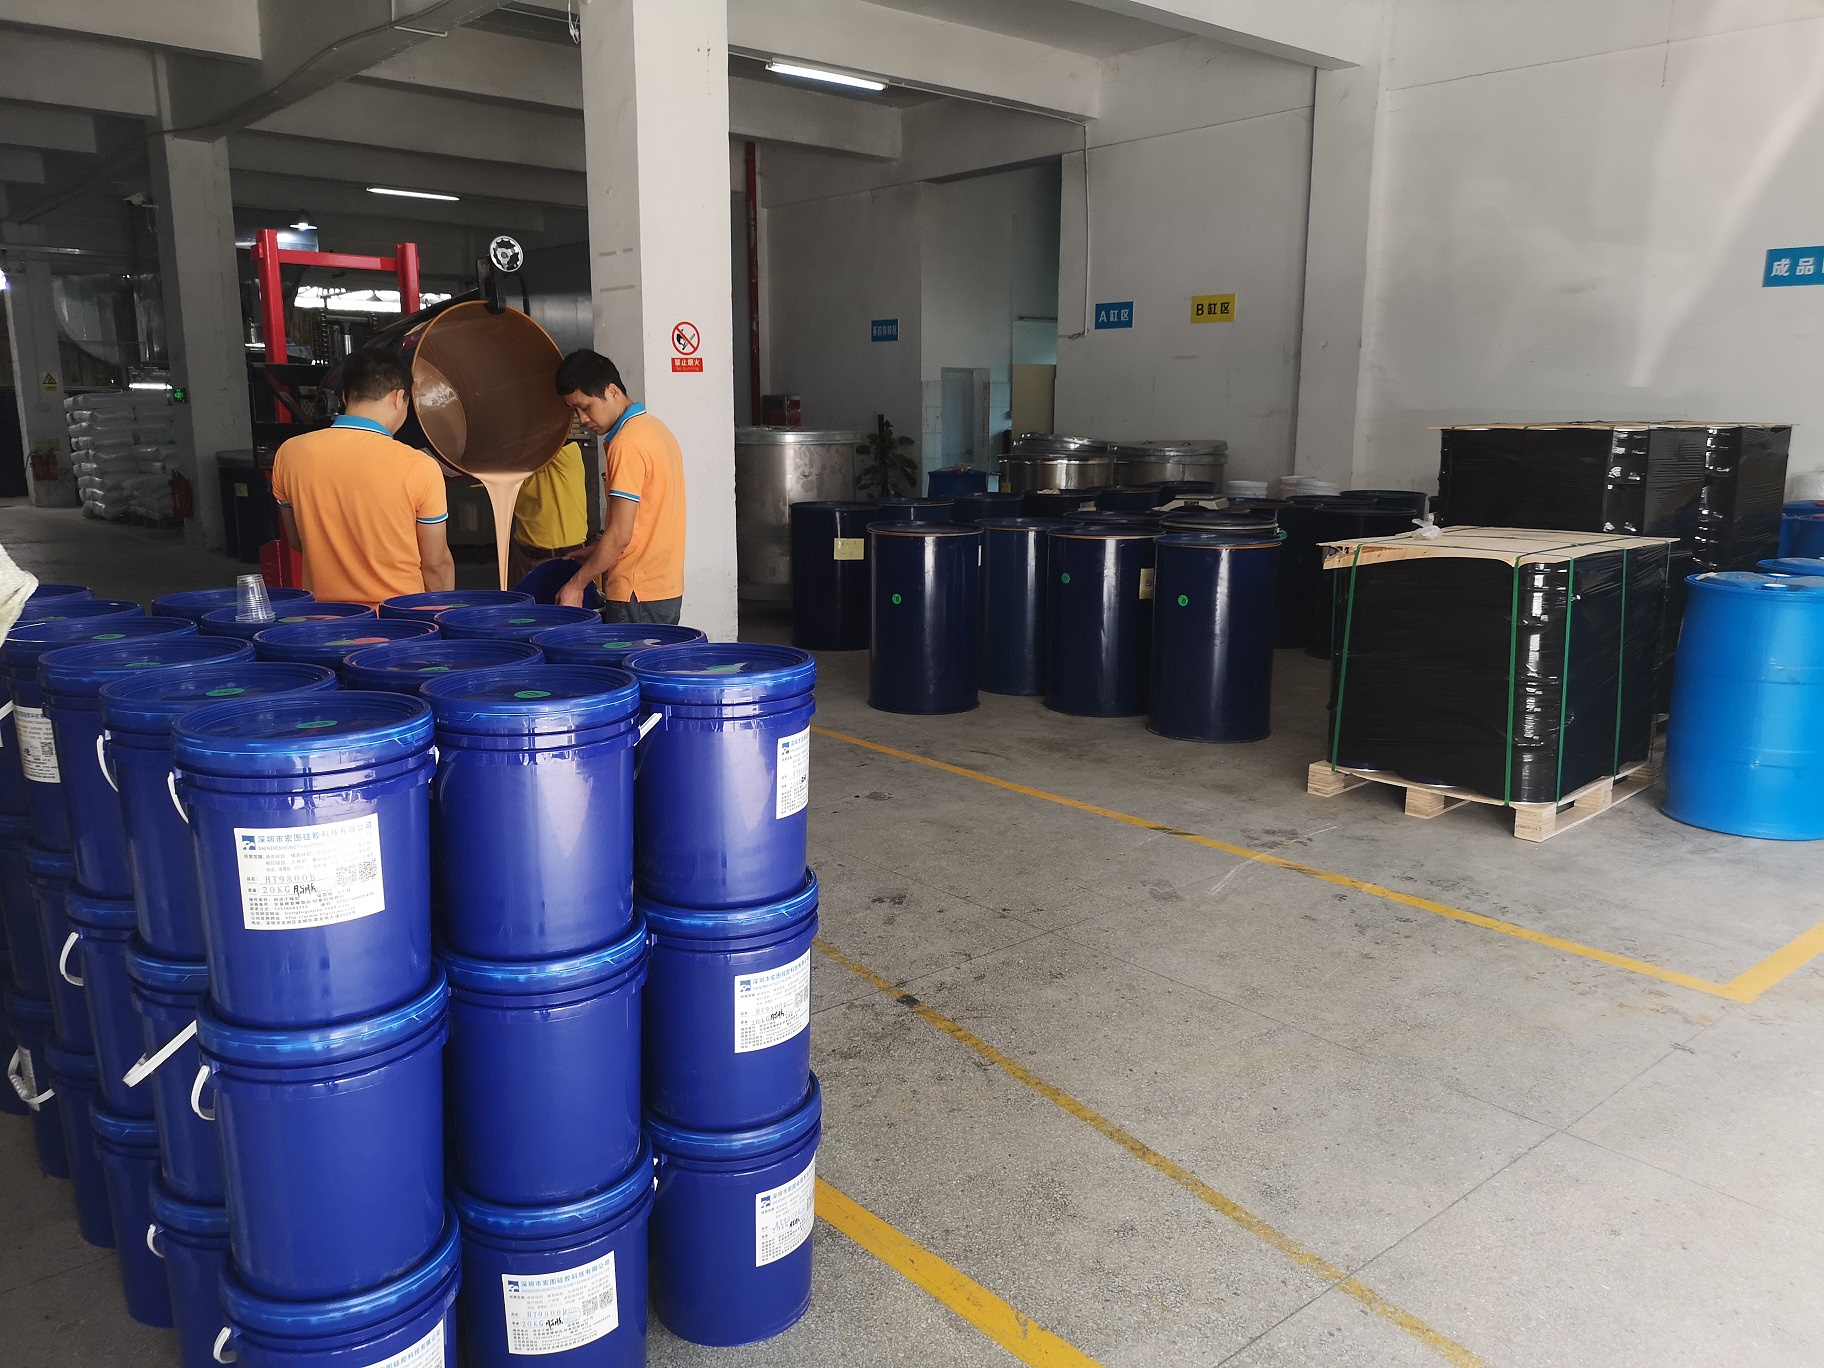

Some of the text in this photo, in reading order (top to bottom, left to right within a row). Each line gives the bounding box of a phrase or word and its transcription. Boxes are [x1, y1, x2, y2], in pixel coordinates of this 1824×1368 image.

[1771, 257, 1824, 277] 成品
[674, 358, 700, 367] 禁止烟火
[262, 885, 291, 894] 20KG
